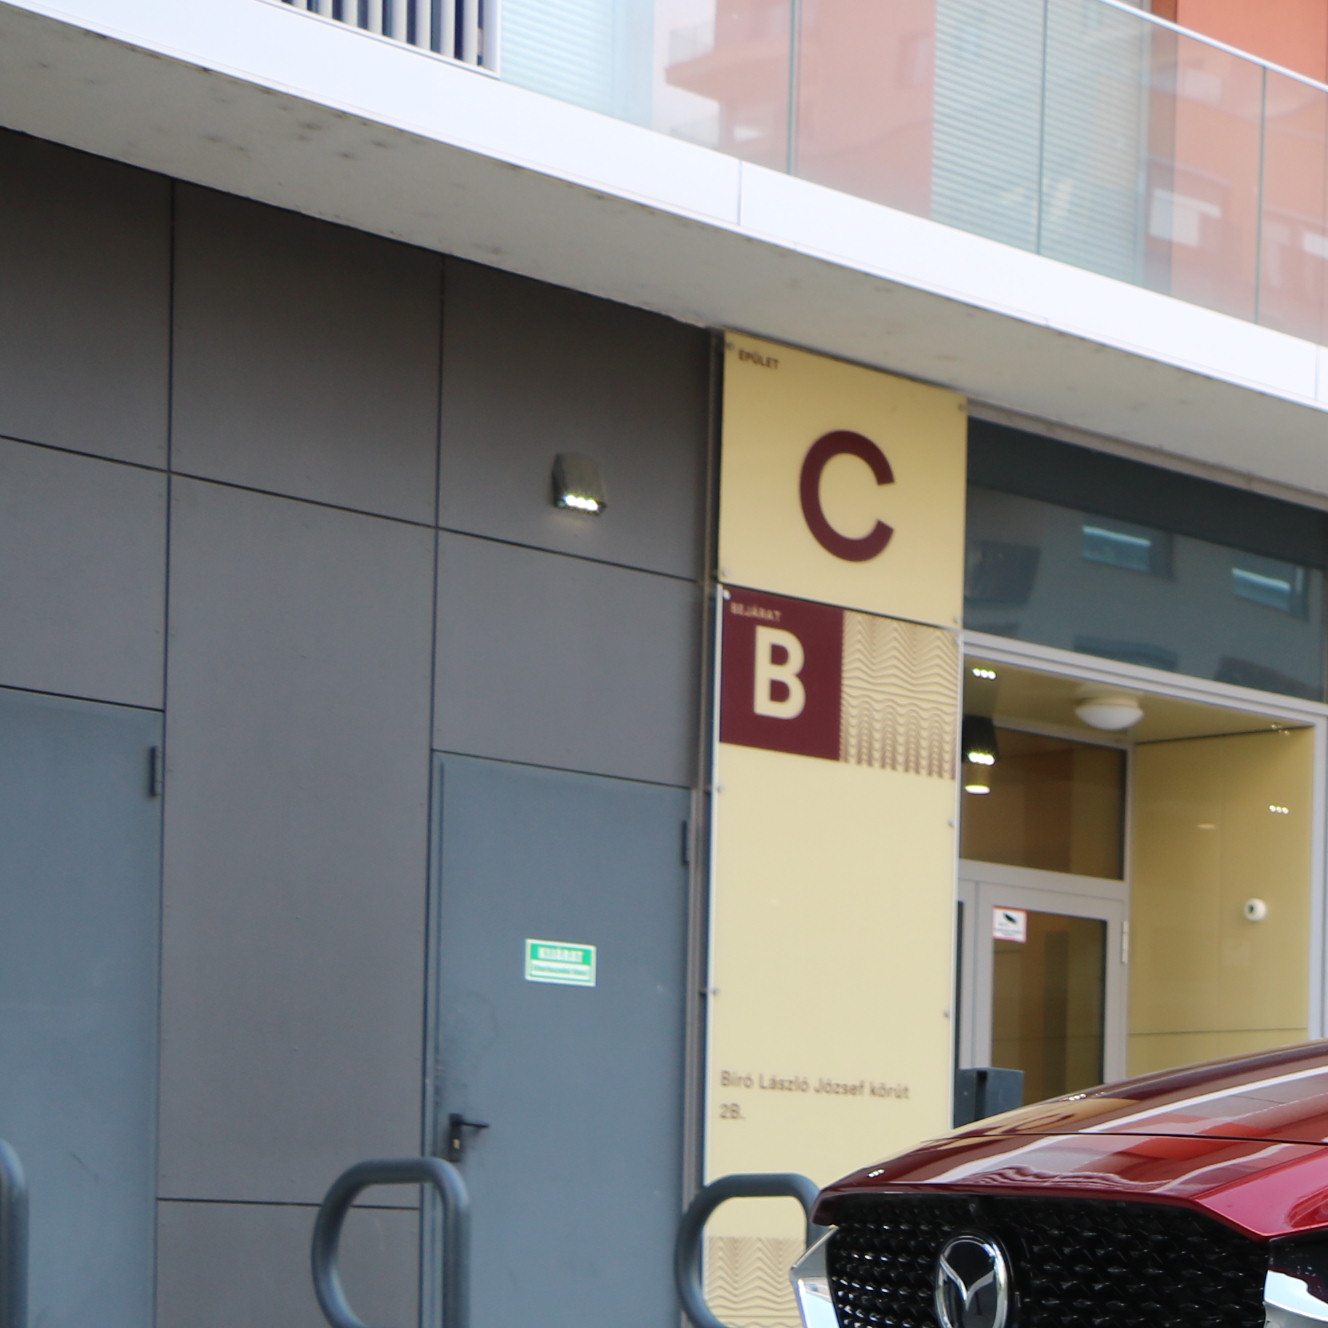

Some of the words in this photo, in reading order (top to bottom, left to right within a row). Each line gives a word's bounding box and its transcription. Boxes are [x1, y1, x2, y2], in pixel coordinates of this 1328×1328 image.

[800, 430, 896, 562] C
[753, 625, 806, 721] B
[759, 1073, 809, 1092] László
[813, 1076, 865, 1096] József
